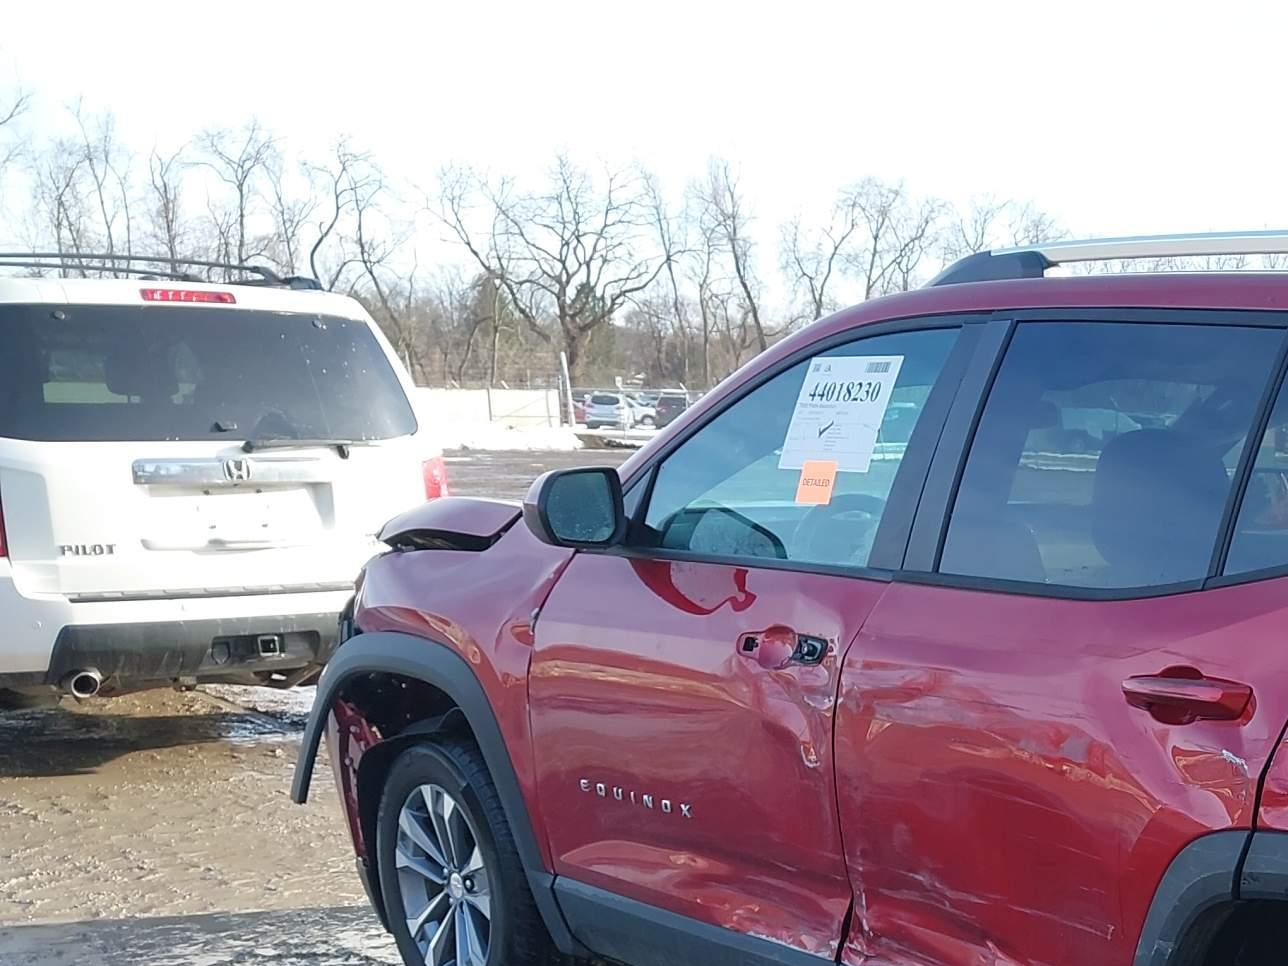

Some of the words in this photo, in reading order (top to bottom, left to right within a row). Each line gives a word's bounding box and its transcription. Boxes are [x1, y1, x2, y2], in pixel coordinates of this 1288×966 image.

[809, 381, 881, 402] 44018230
[802, 478, 830, 487] DETAILED
[59, 544, 117, 557] PILOT
[580, 779, 691, 818] EQUINOX
